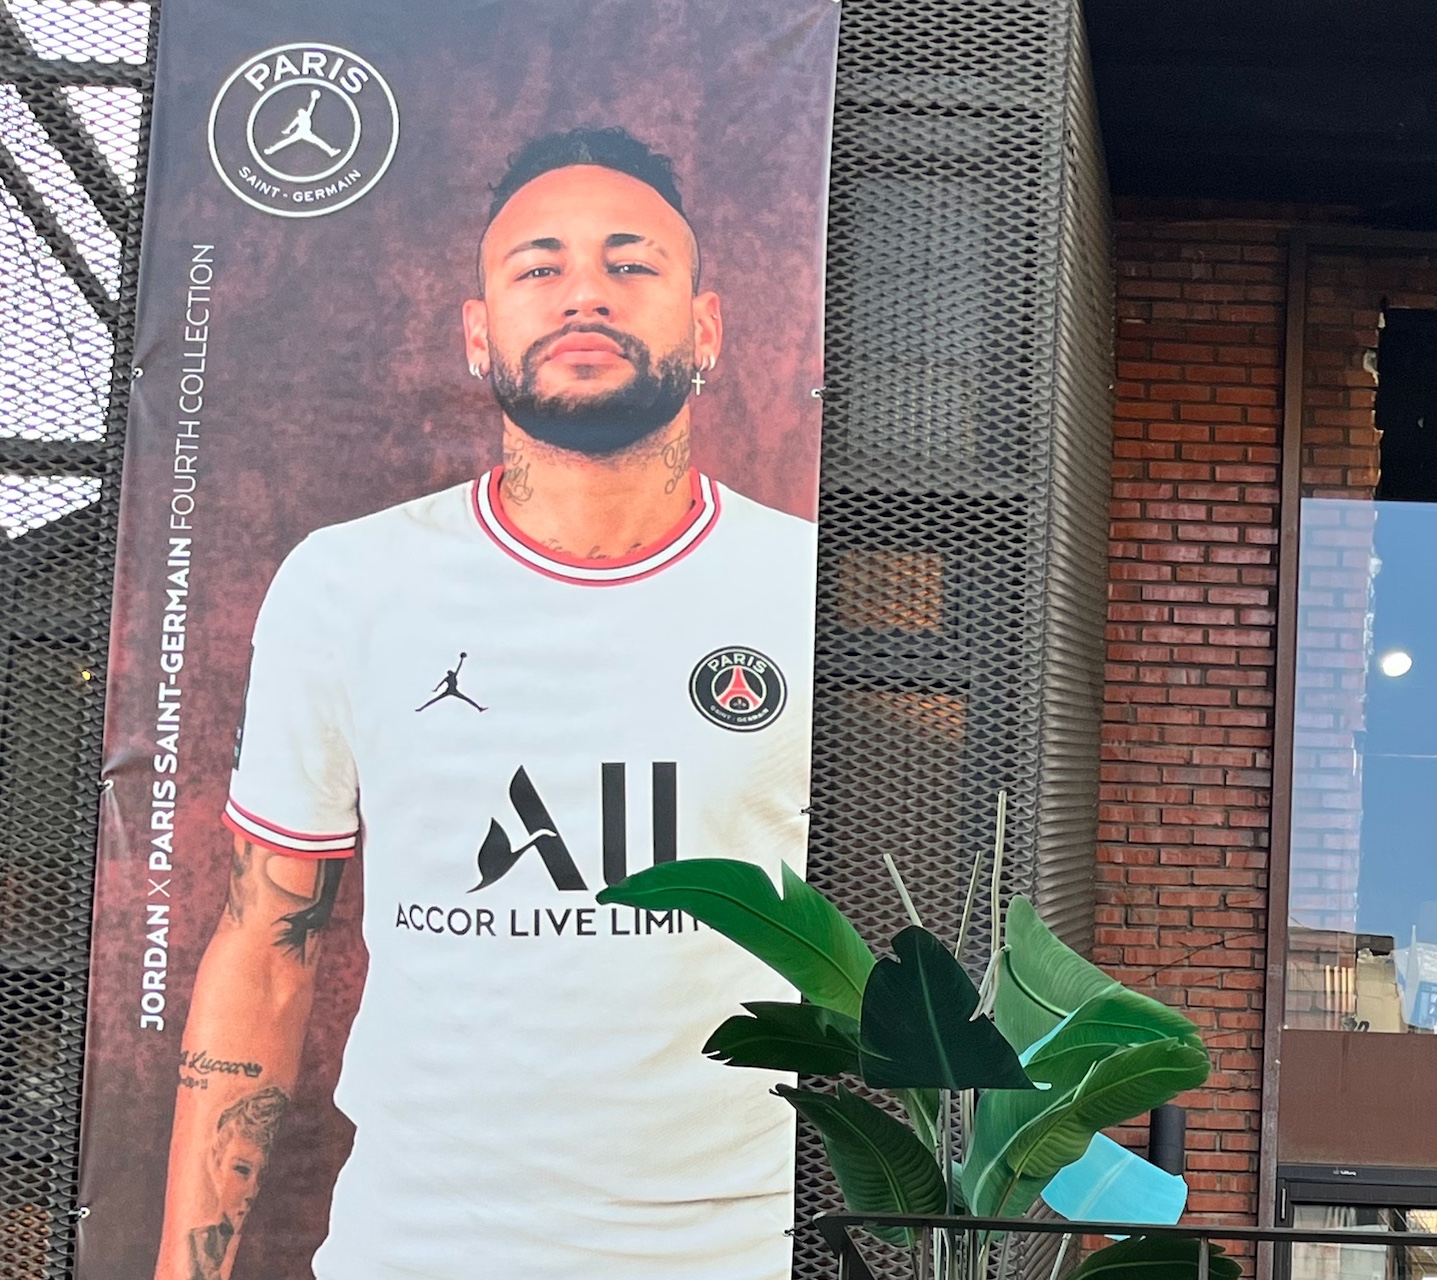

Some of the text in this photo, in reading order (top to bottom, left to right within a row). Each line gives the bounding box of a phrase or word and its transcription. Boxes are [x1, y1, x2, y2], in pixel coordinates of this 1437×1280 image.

[244, 52, 369, 94] PARIS
[238, 166, 362, 203] SAINT GERMAIN
[179, 244, 216, 413] COLLECTION
[170, 420, 201, 530] FOURTH
[154, 537, 193, 775] SAINT-GERMAIN
[707, 653, 768, 674] PARIS
[148, 779, 176, 871] PARIS
[396, 902, 497, 937] ACCOR
[510, 907, 598, 937] LIVE
[140, 904, 170, 1031] JORDAN
